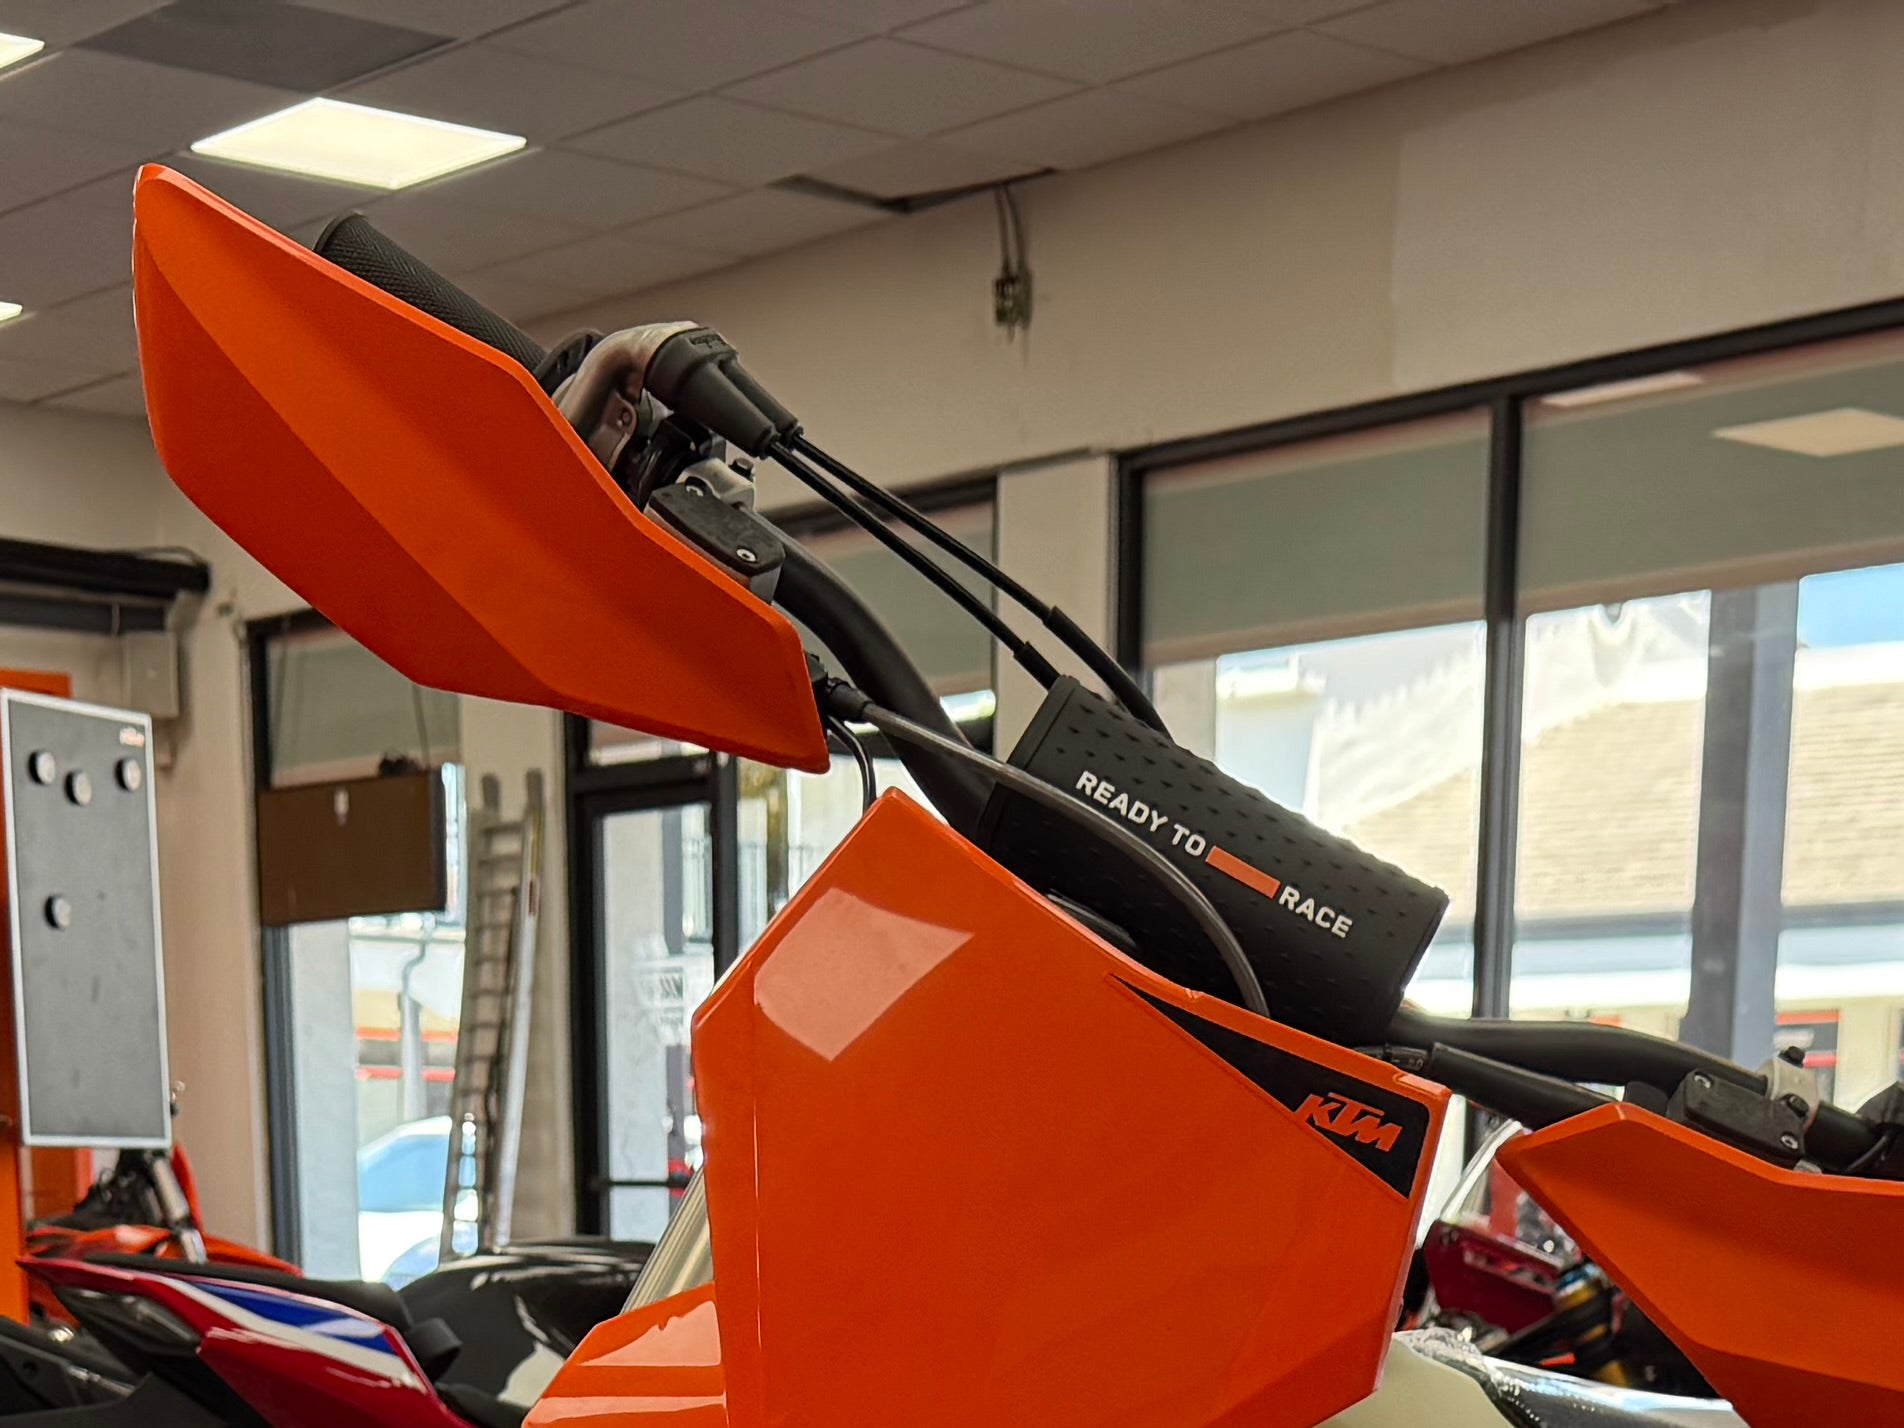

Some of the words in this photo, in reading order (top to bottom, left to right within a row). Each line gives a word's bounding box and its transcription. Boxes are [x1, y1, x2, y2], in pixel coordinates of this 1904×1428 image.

[1075, 770, 1168, 832] READY
[1171, 823, 1207, 857] TO
[1278, 885, 1353, 938] RACE
[1295, 1092, 1403, 1152] KTM
